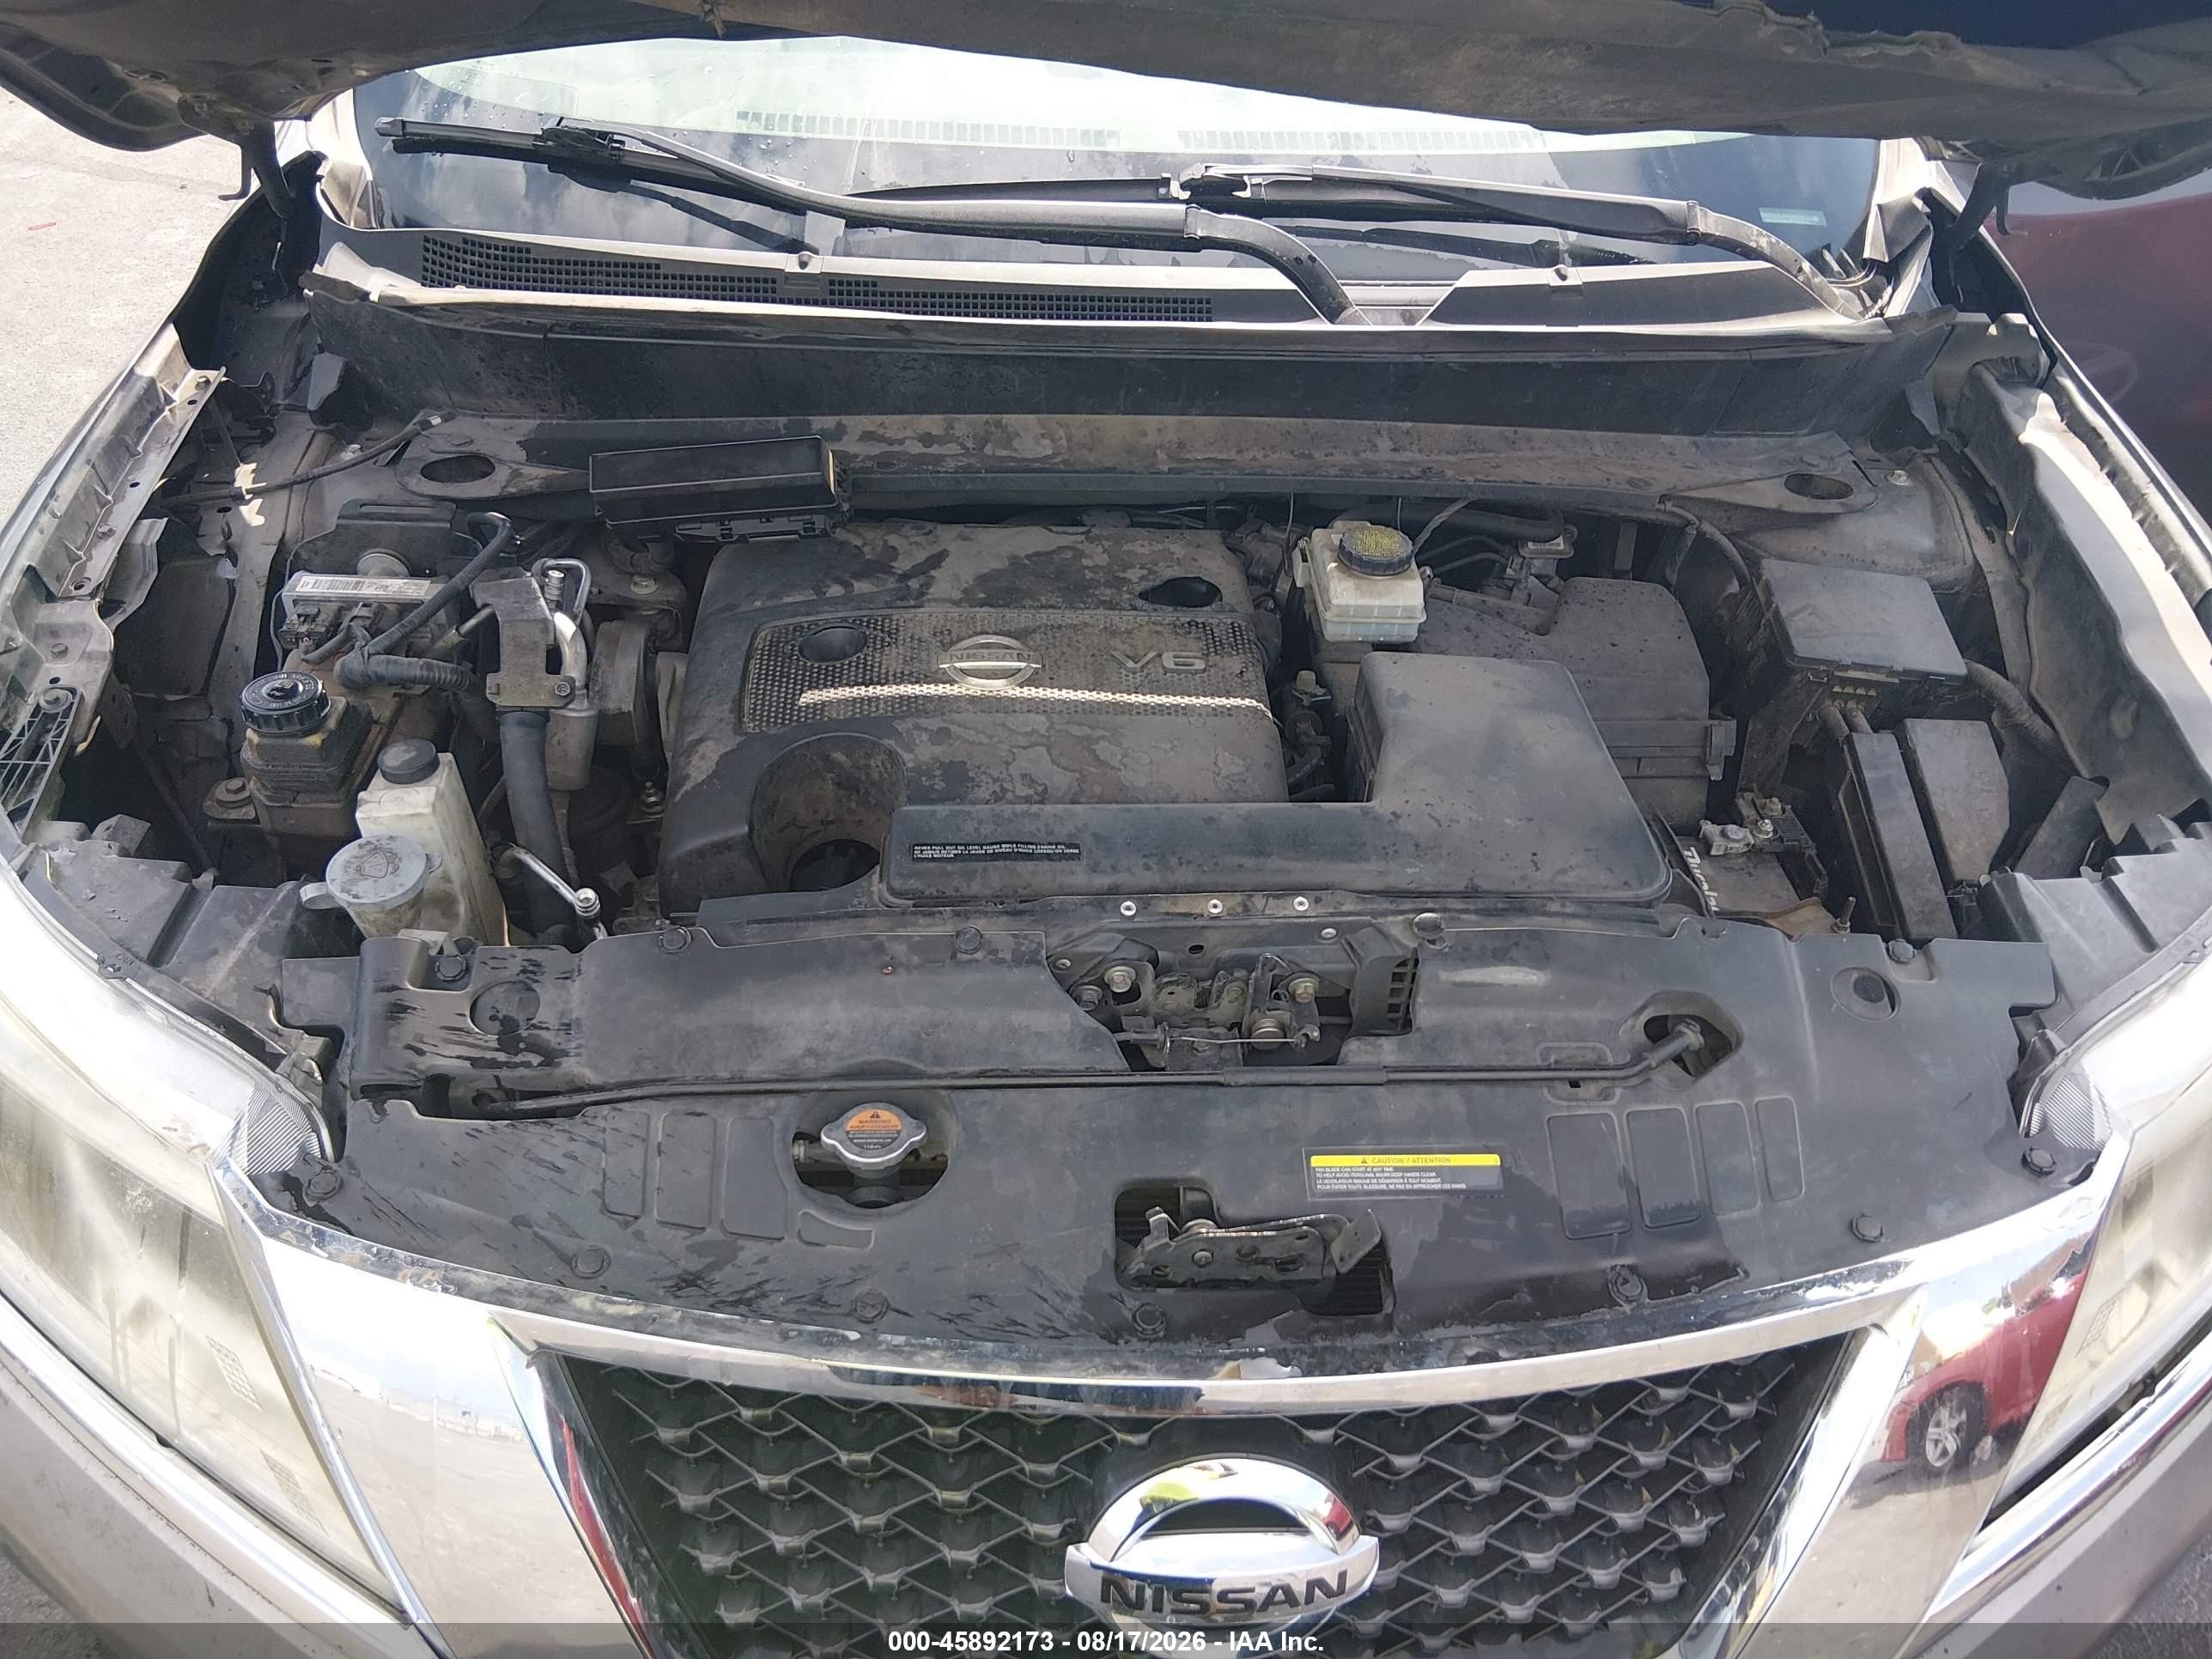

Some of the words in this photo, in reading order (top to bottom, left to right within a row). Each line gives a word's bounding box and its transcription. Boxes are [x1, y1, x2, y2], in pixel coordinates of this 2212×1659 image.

[950, 651, 1031, 661] NISSAN
[1110, 650, 1206, 674] V6
[1100, 1570, 1347, 1615] NISSAN
